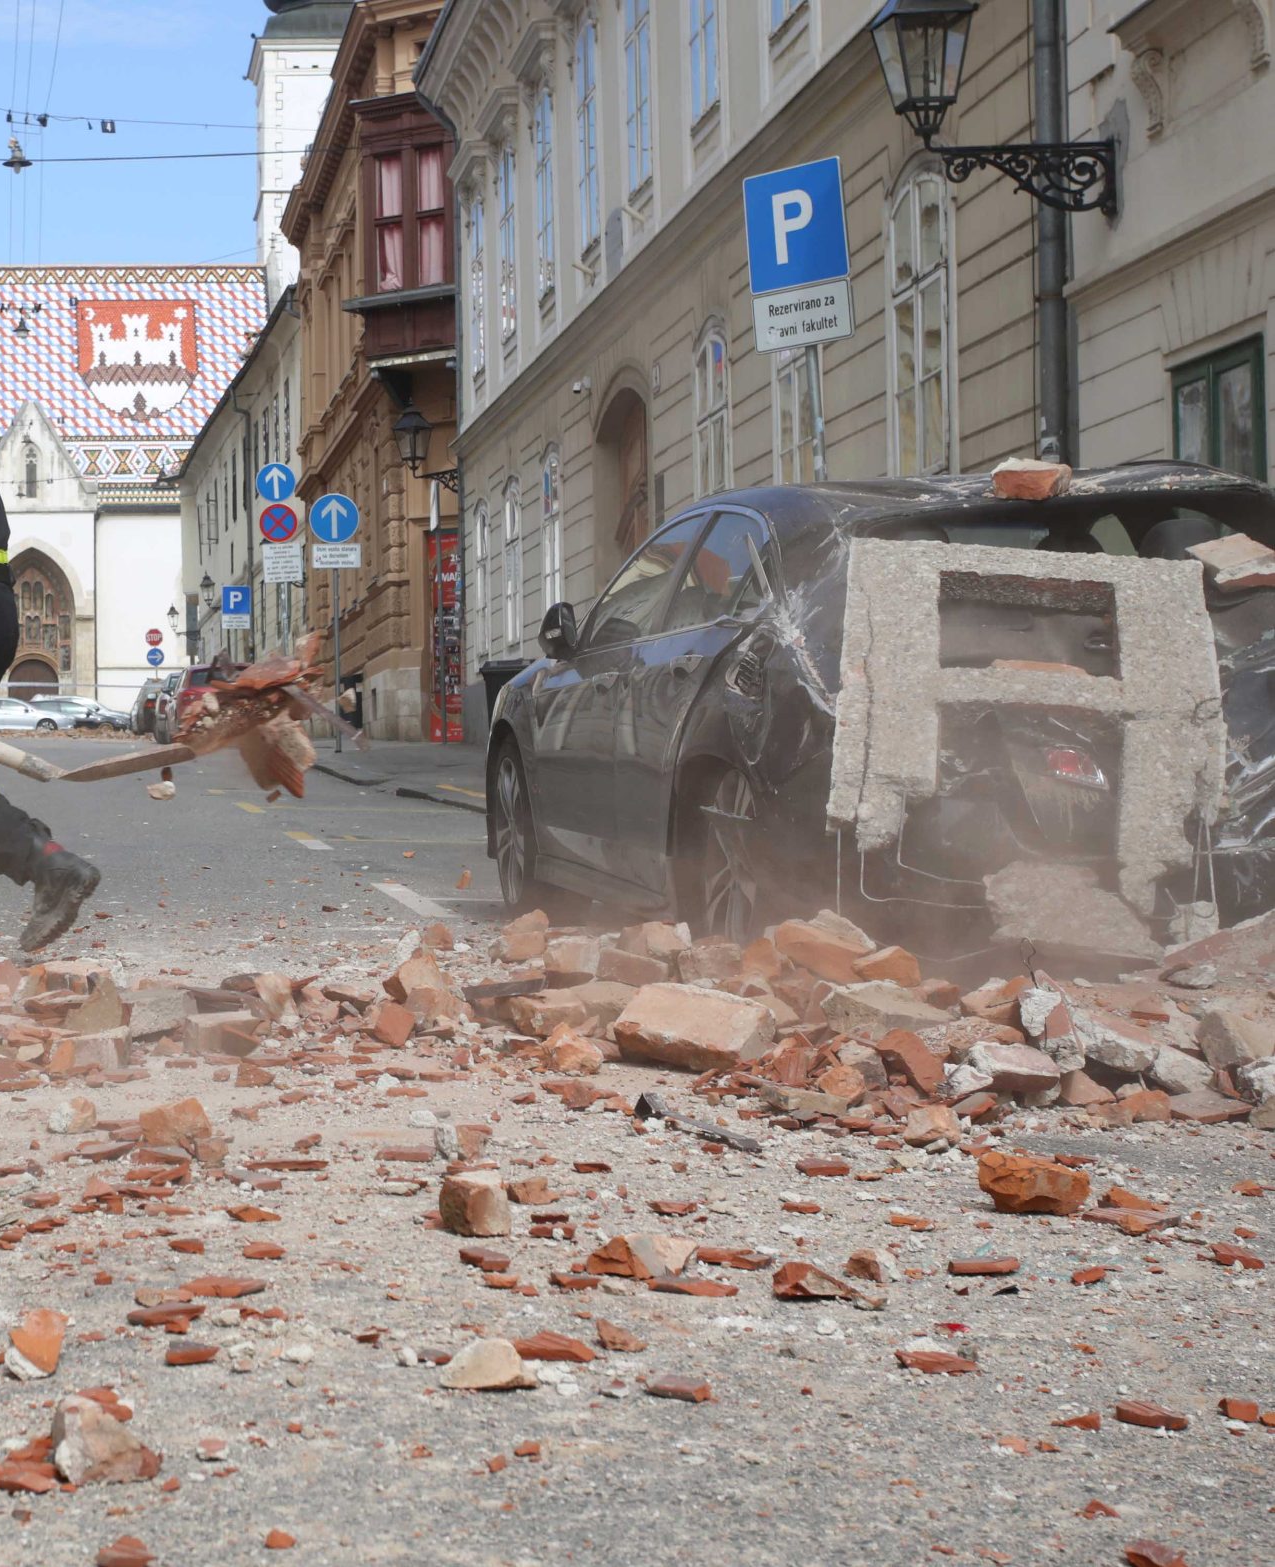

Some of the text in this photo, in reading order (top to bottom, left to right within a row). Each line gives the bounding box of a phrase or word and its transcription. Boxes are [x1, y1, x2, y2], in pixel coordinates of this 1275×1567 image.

[772, 189, 813, 265] P
[768, 295, 835, 318] Rezervirano za
[802, 315, 838, 333] fakultet
[230, 592, 242, 609] P
[146, 633, 162, 641] STOP
